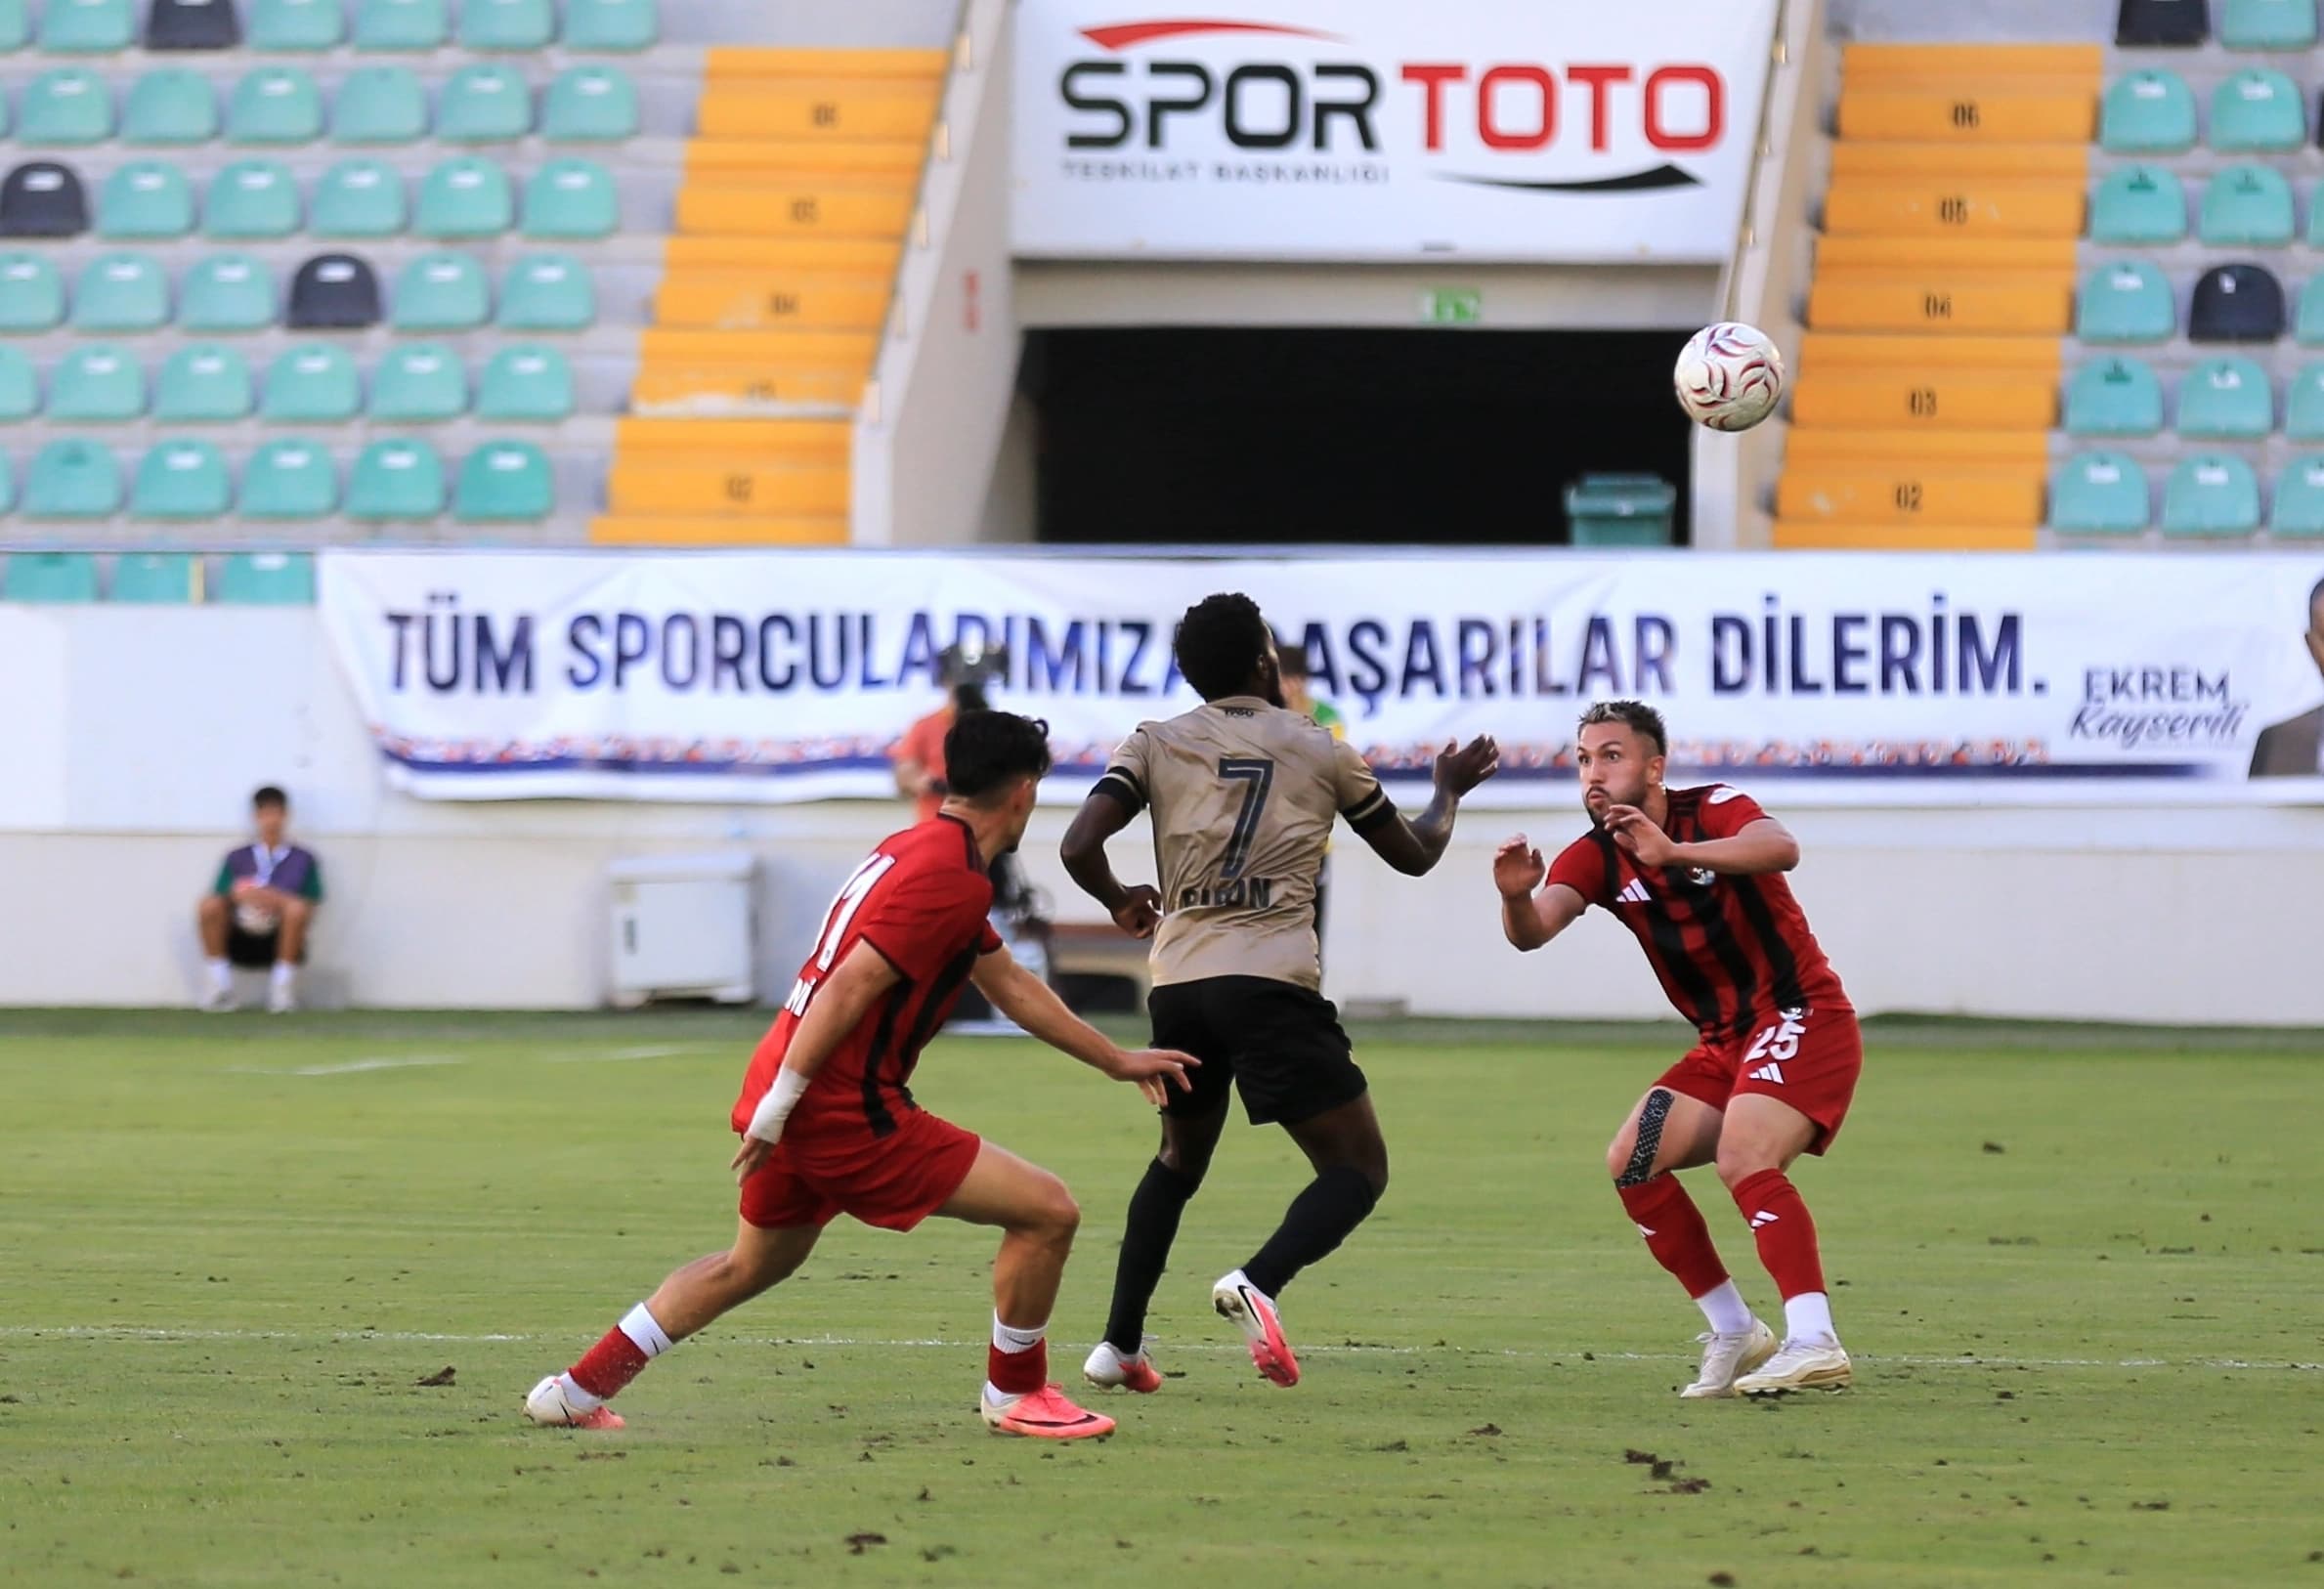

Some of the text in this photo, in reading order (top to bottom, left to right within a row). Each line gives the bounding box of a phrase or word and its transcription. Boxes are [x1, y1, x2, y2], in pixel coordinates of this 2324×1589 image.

[1060, 63, 1727, 152] SPOR TOTO
[385, 591, 2046, 719] TÜM SPORCULAIMIZ AŞARILAR DİLERİM.
[2085, 668, 2229, 702] EKREM
[1218, 757, 1274, 880] 7
[1743, 1020, 1807, 1064] 25
